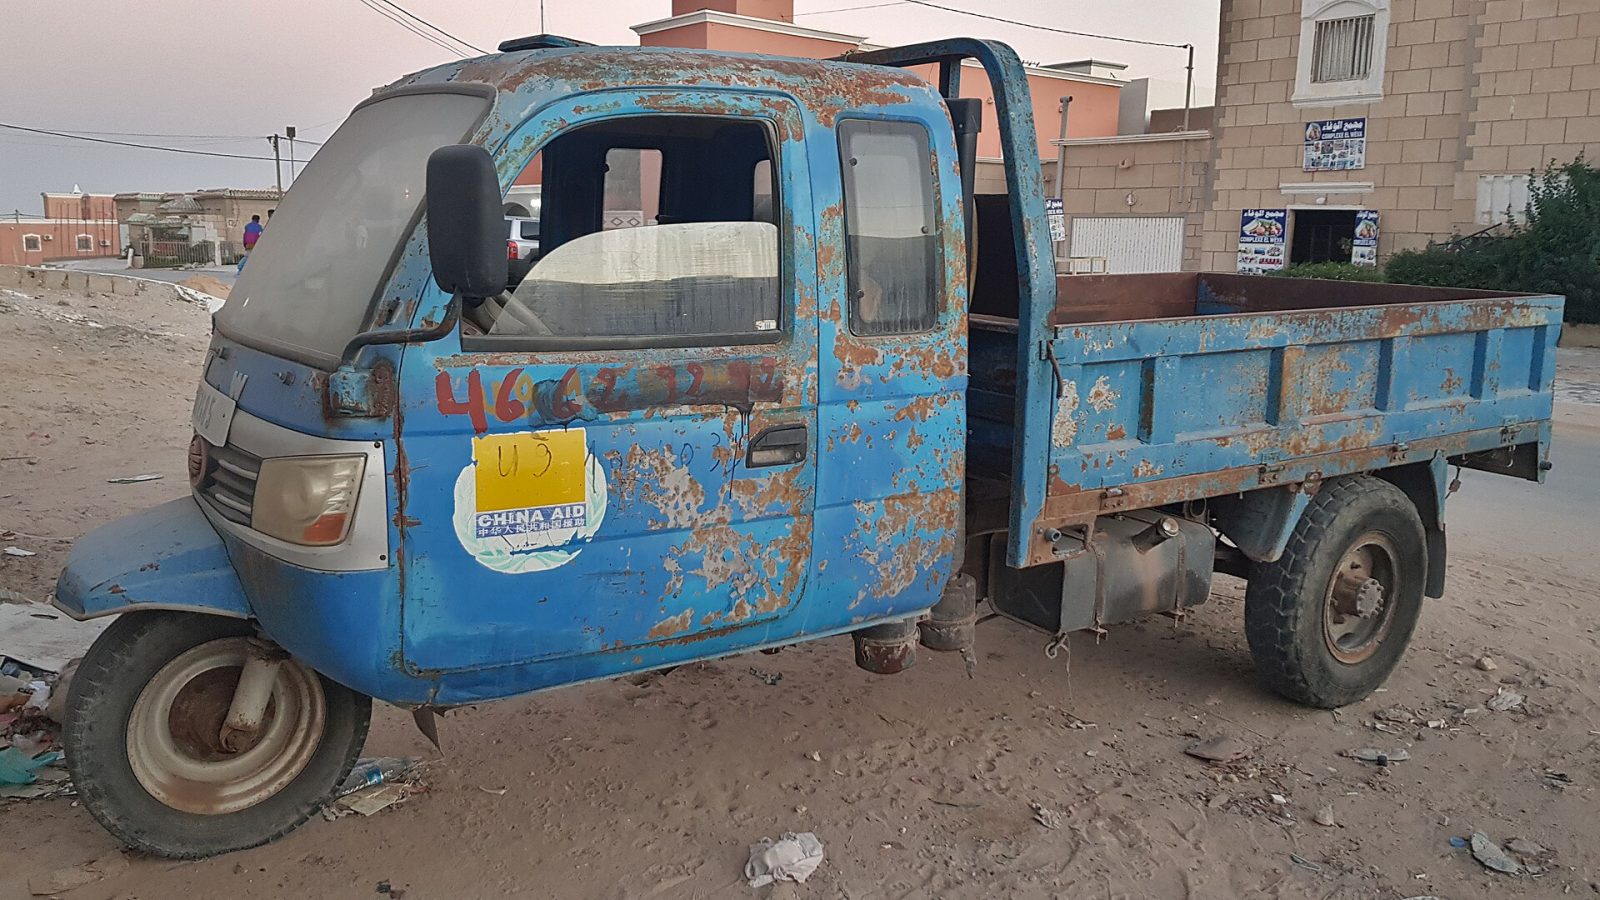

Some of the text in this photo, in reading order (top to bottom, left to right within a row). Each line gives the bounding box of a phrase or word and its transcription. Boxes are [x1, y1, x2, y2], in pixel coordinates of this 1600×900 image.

[478, 505, 585, 527] CHINA AID
[478, 518, 585, 537] 中华人民共和国援助
